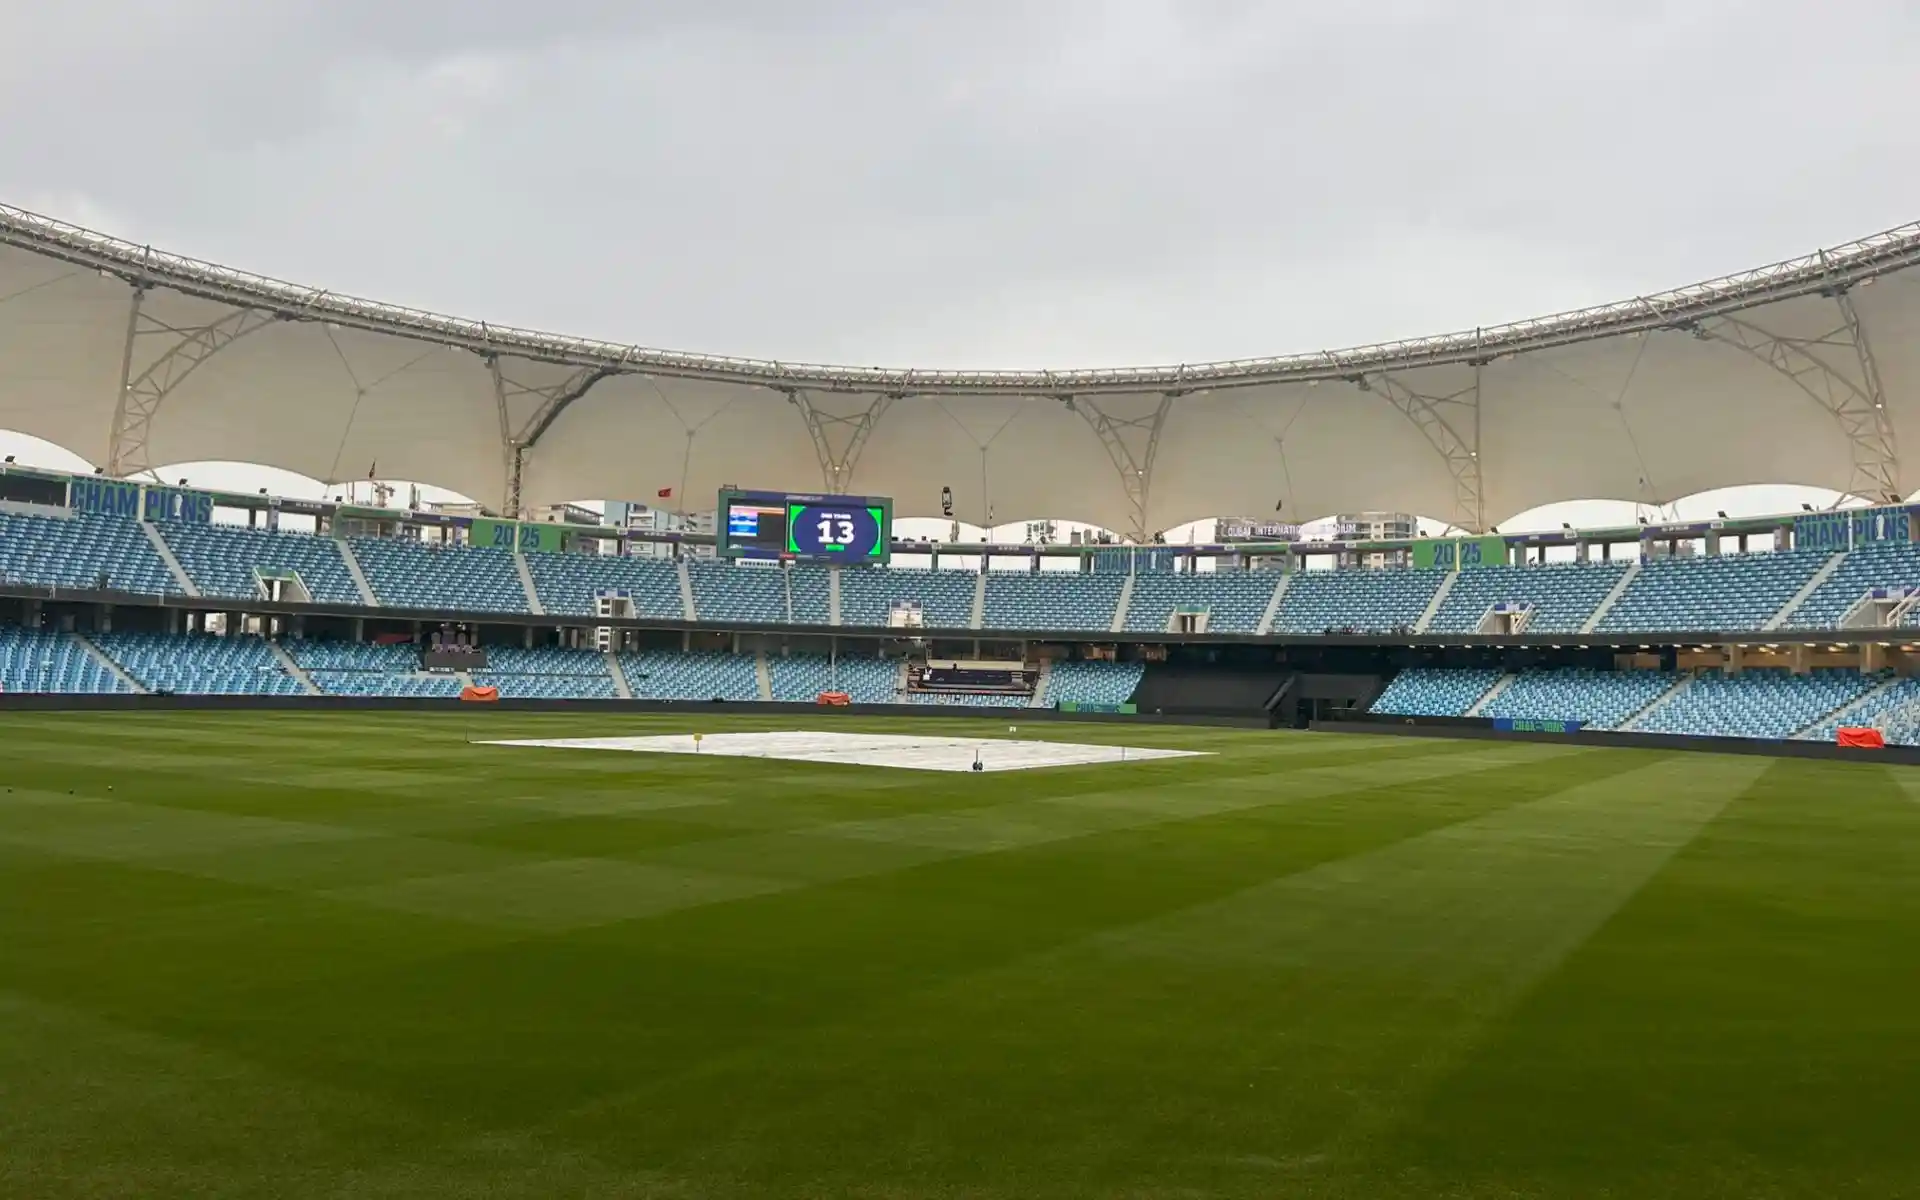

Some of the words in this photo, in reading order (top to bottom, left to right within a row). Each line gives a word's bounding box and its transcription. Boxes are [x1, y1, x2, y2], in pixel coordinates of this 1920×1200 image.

[70, 481, 211, 521] CHAMPIONS
[494, 525, 540, 548] 2025
[816, 520, 855, 545] 13
[1795, 515, 1908, 546] CHAMPIONS
[1433, 542, 1482, 565] 2025
